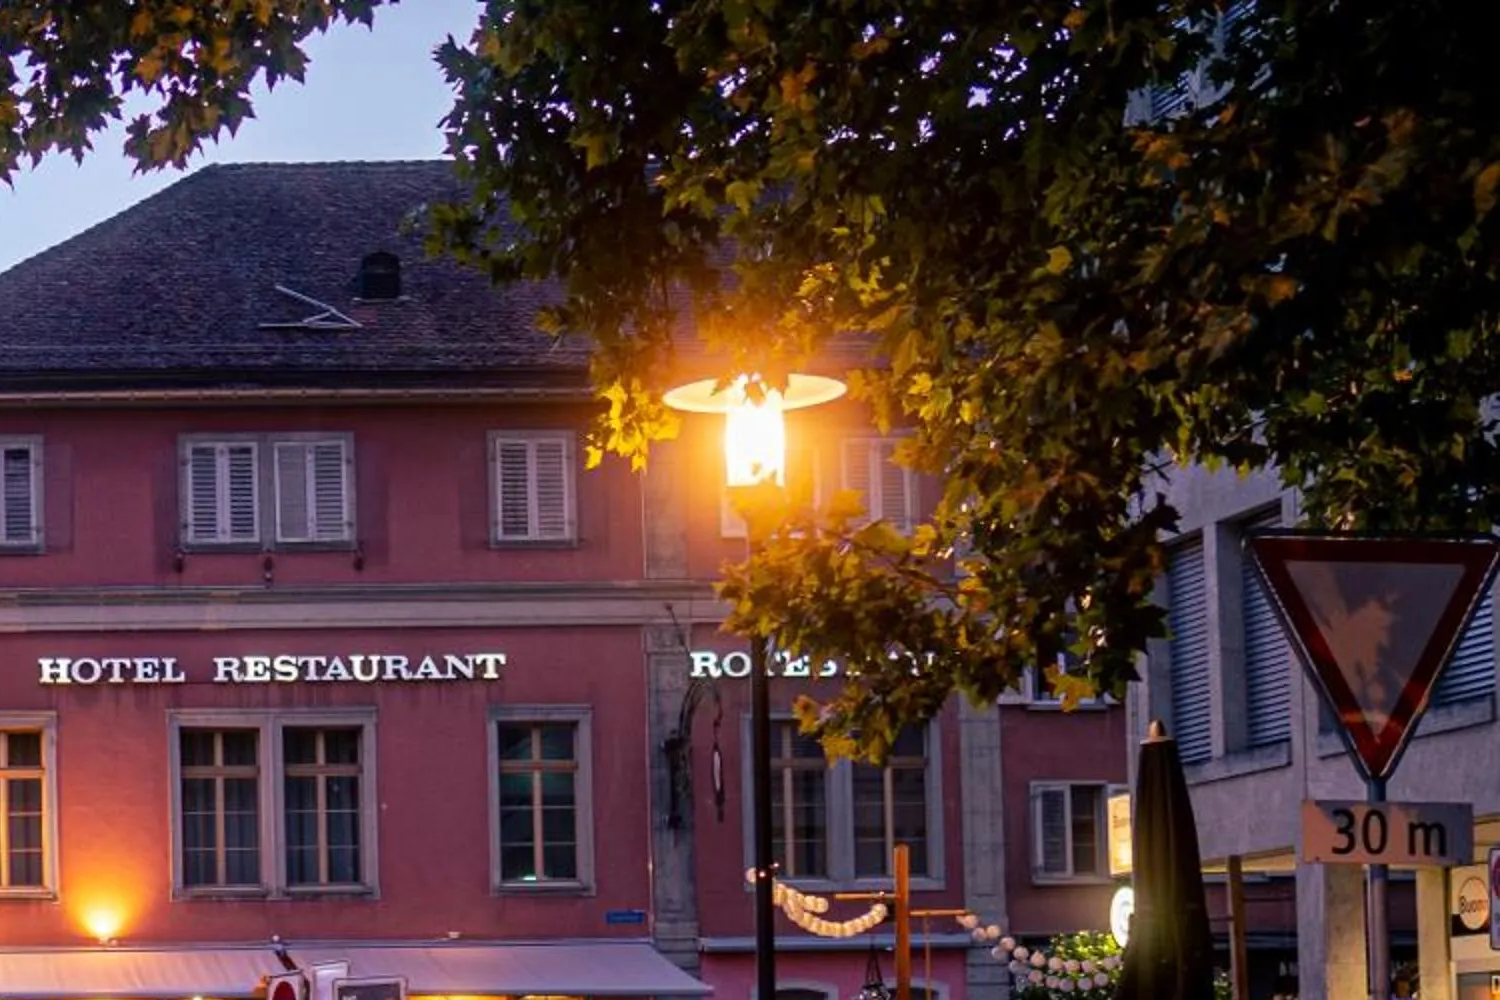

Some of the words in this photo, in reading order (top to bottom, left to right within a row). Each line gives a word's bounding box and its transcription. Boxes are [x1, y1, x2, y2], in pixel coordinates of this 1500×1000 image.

[37, 657, 186, 684] HOTEL
[212, 653, 506, 683] RESTAURANT
[689, 650, 838, 678] ROES
[1331, 809, 1388, 855] 30
[1408, 821, 1447, 857] m
